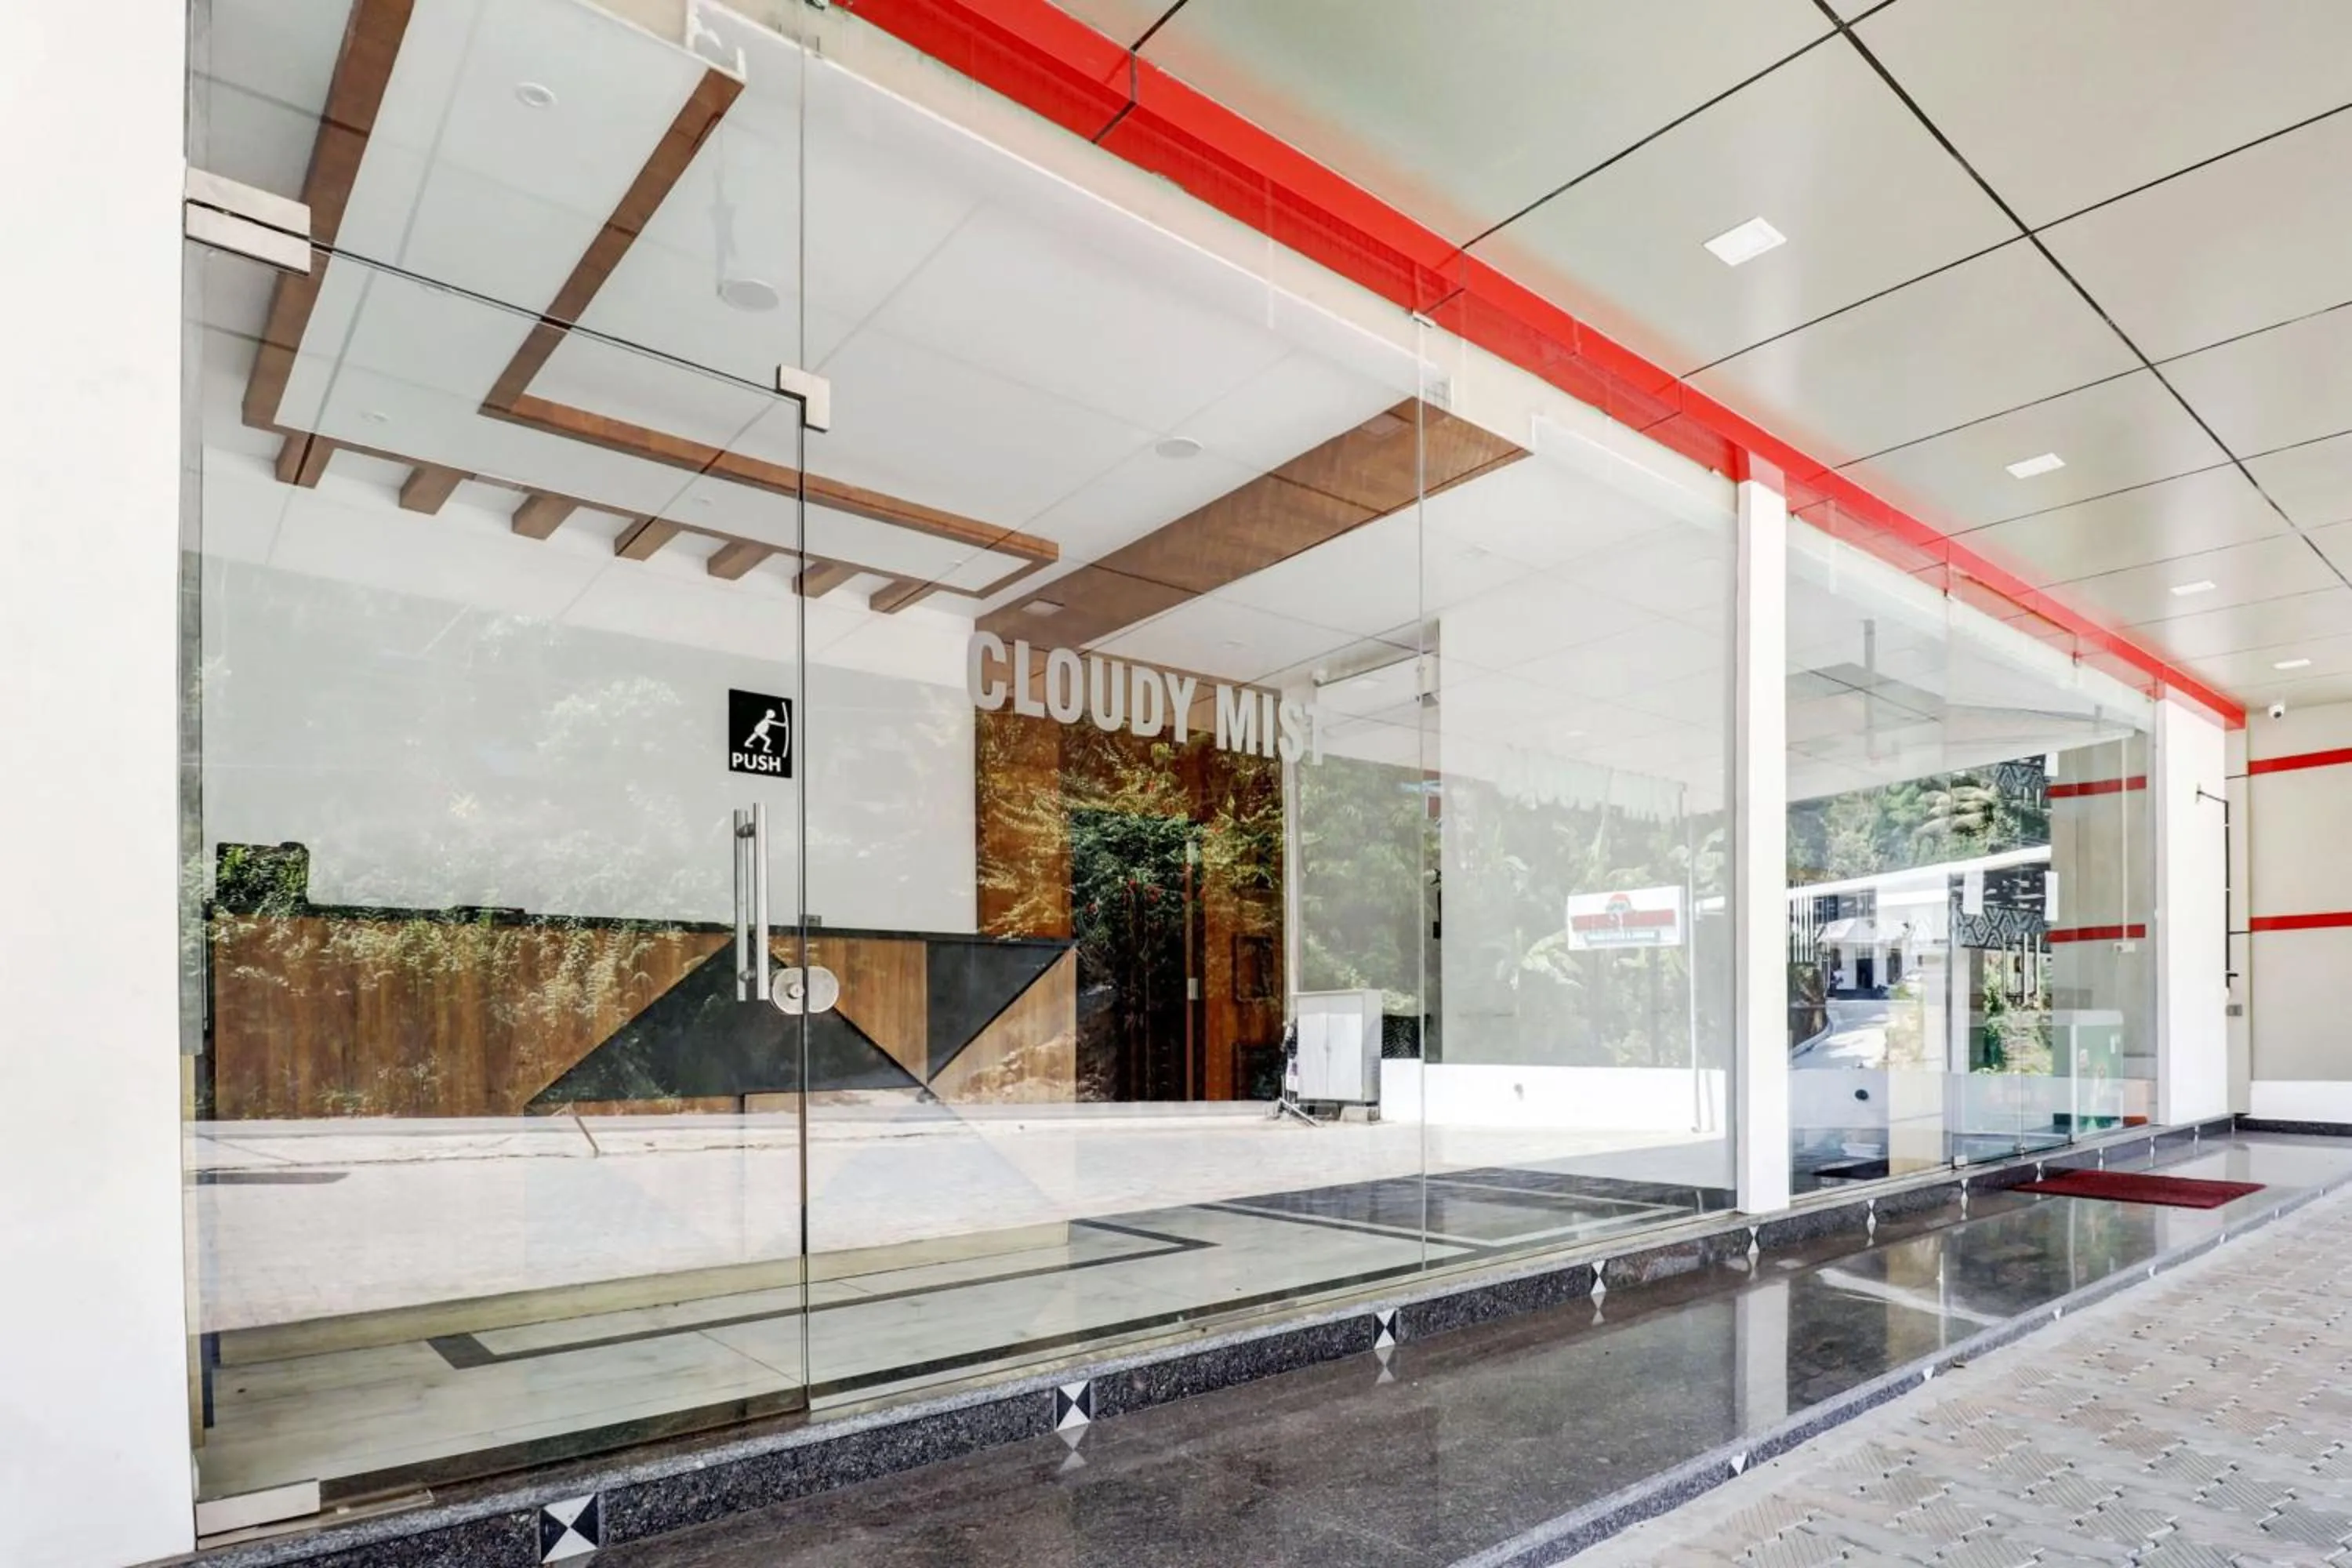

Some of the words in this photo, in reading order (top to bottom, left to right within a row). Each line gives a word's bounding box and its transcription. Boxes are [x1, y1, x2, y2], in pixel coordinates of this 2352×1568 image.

[967, 630, 1197, 744] CLOUDY
[1216, 684, 1329, 765] MIST
[731, 752, 781, 772] PUSH
